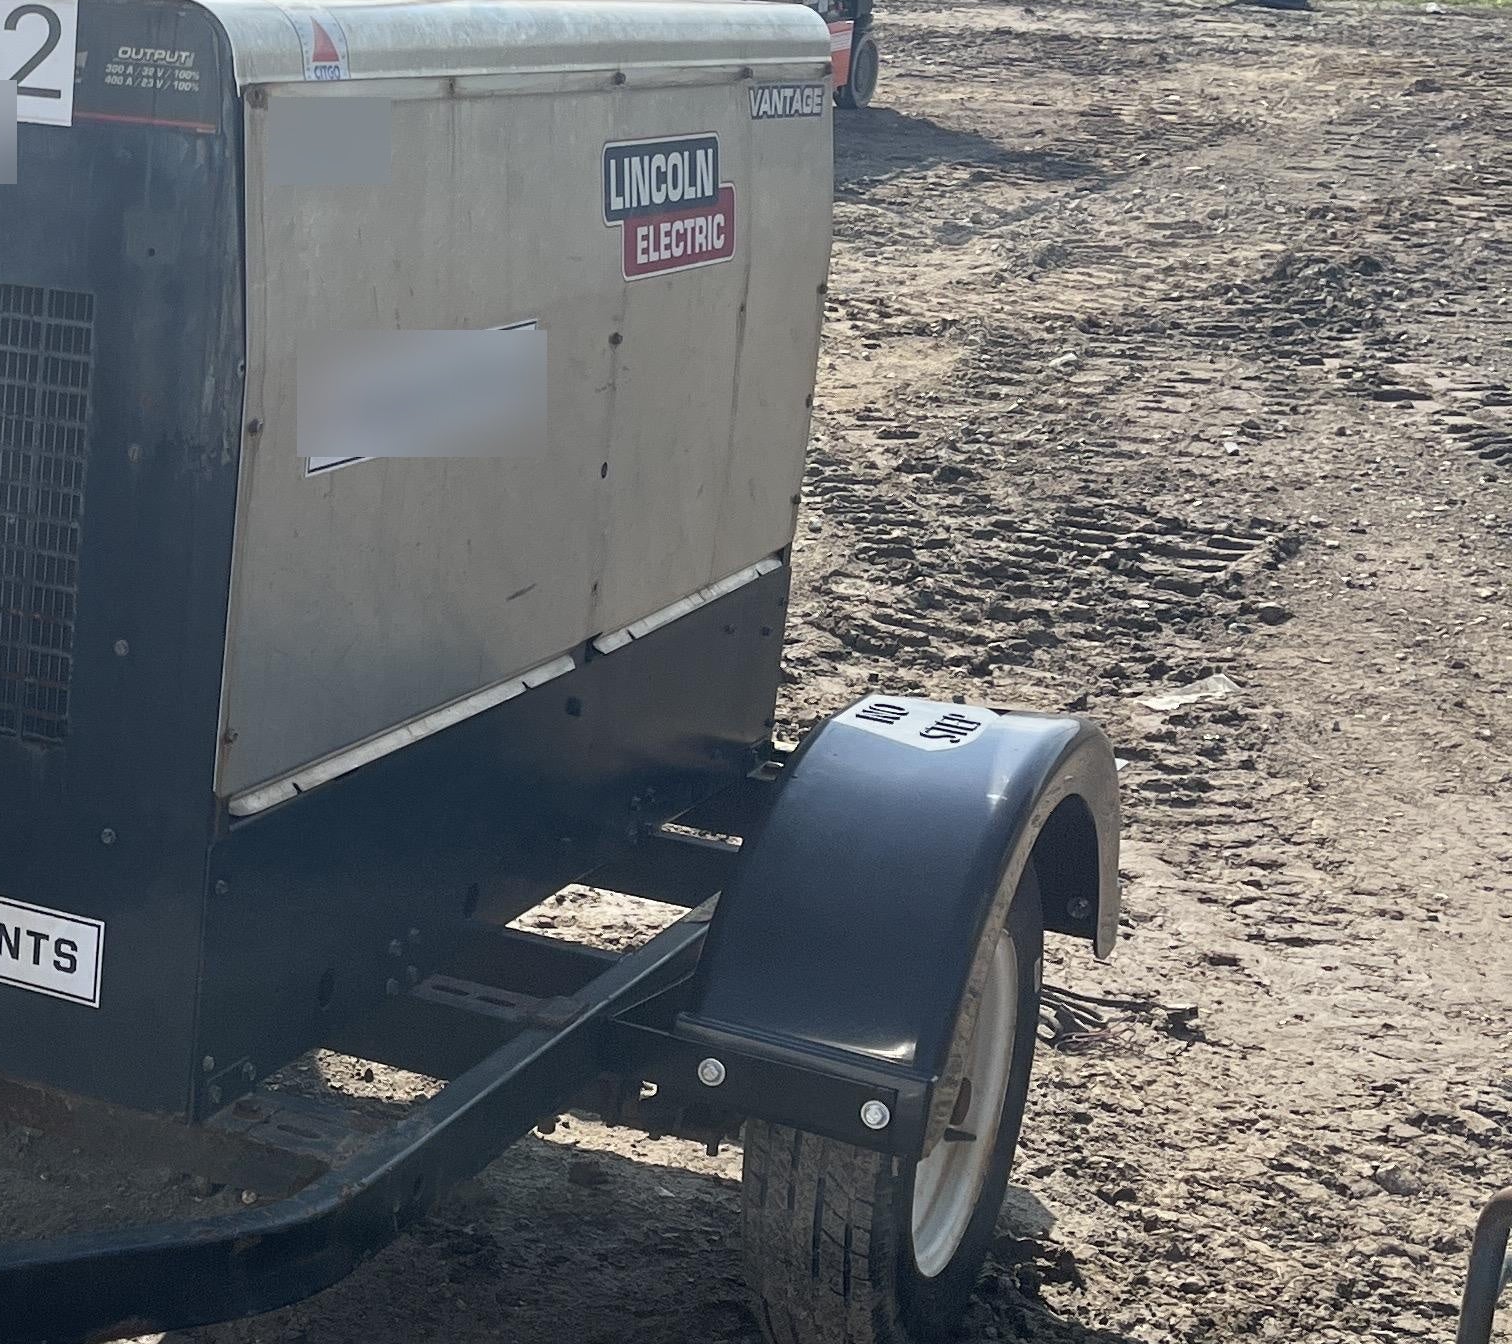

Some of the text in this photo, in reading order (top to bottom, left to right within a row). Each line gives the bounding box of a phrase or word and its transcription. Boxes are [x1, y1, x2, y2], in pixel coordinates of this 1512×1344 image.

[117, 46, 190, 64] OUTPUT
[314, 65, 341, 80] CITGO
[749, 85, 824, 118] VANTAGE
[609, 148, 714, 210] LINCOLN
[636, 213, 725, 264] ELECTRIC
[855, 703, 910, 725] NO
[919, 713, 982, 744] STEP
